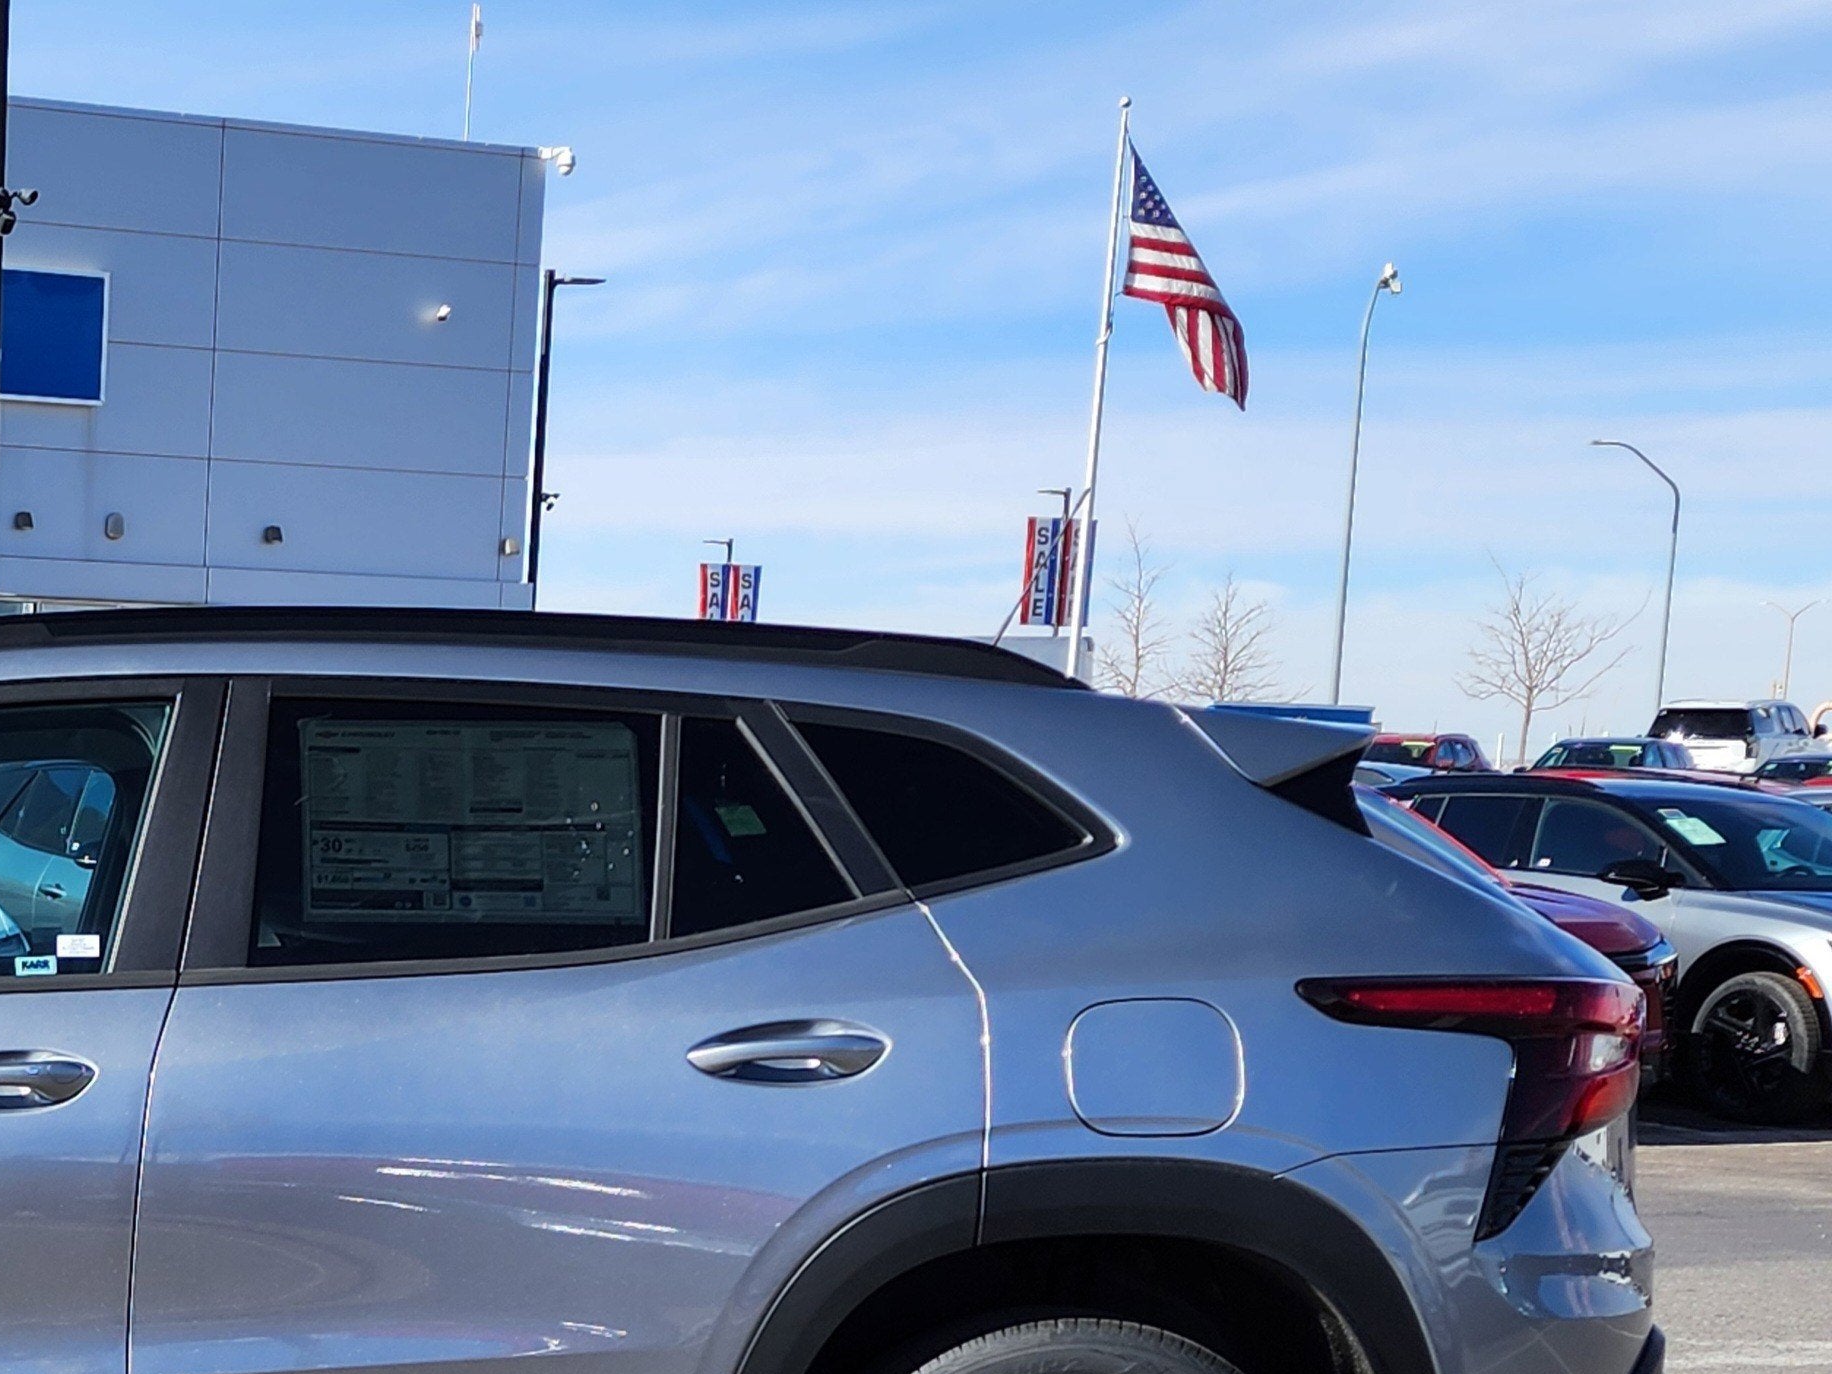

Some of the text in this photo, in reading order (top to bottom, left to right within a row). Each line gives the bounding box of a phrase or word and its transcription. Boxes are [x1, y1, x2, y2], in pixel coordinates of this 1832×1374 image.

[709, 571, 721, 620] SA
[1032, 527, 1049, 617] SALE
[739, 574, 752, 621] SA
